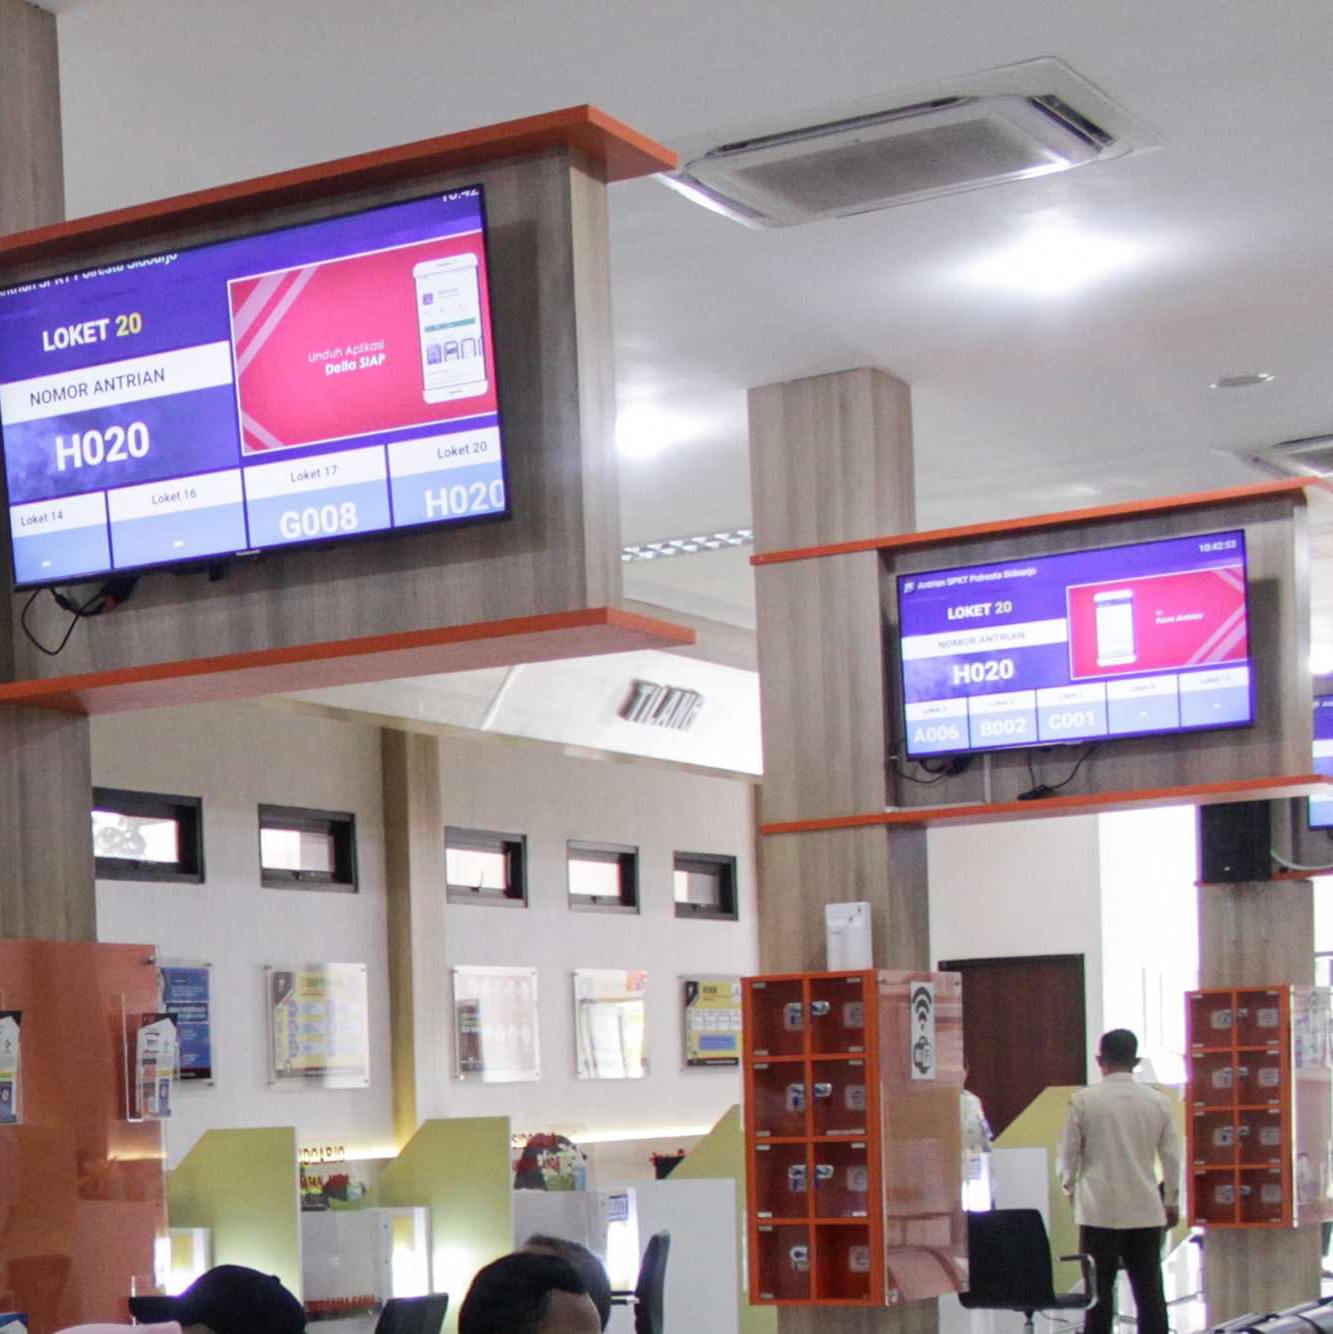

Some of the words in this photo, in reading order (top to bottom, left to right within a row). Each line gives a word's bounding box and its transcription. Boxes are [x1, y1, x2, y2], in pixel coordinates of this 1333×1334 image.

[42, 319, 110, 352] LOKET
[114, 312, 143, 338] 20
[307, 346, 343, 364] Unduh
[344, 337, 386, 361] Aplikasi
[325, 356, 357, 377] Delta
[358, 352, 387, 372] SIAP
[29, 377, 89, 407] NOMOR
[92, 366, 166, 396] ANTRIAN
[55, 421, 151, 472] H020
[436, 443, 469, 461] Loket
[469, 440, 489, 456] 20
[290, 466, 321, 483] Loket
[322, 463, 339, 479] 17
[151, 489, 181, 507] Loket
[182, 487, 198, 501] 16
[20, 511, 49, 528] Loket
[50, 509, 64, 523] 14
[279, 501, 359, 540] G008
[917, 579, 945, 590] Antrian
[946, 575, 969, 587] SPKT
[1003, 566, 1038, 580] Sidoarjo
[947, 603, 992, 621] LOKET
[994, 600, 1014, 616] 20
[938, 636, 977, 649] NOMOR
[979, 630, 1026, 645] ANTRIAN
[952, 658, 1015, 685] H020
[617, 678, 706, 732] TILANG
[980, 717, 1027, 738] B002
[1048, 711, 1095, 731] C001
[913, 724, 960, 745] A006
